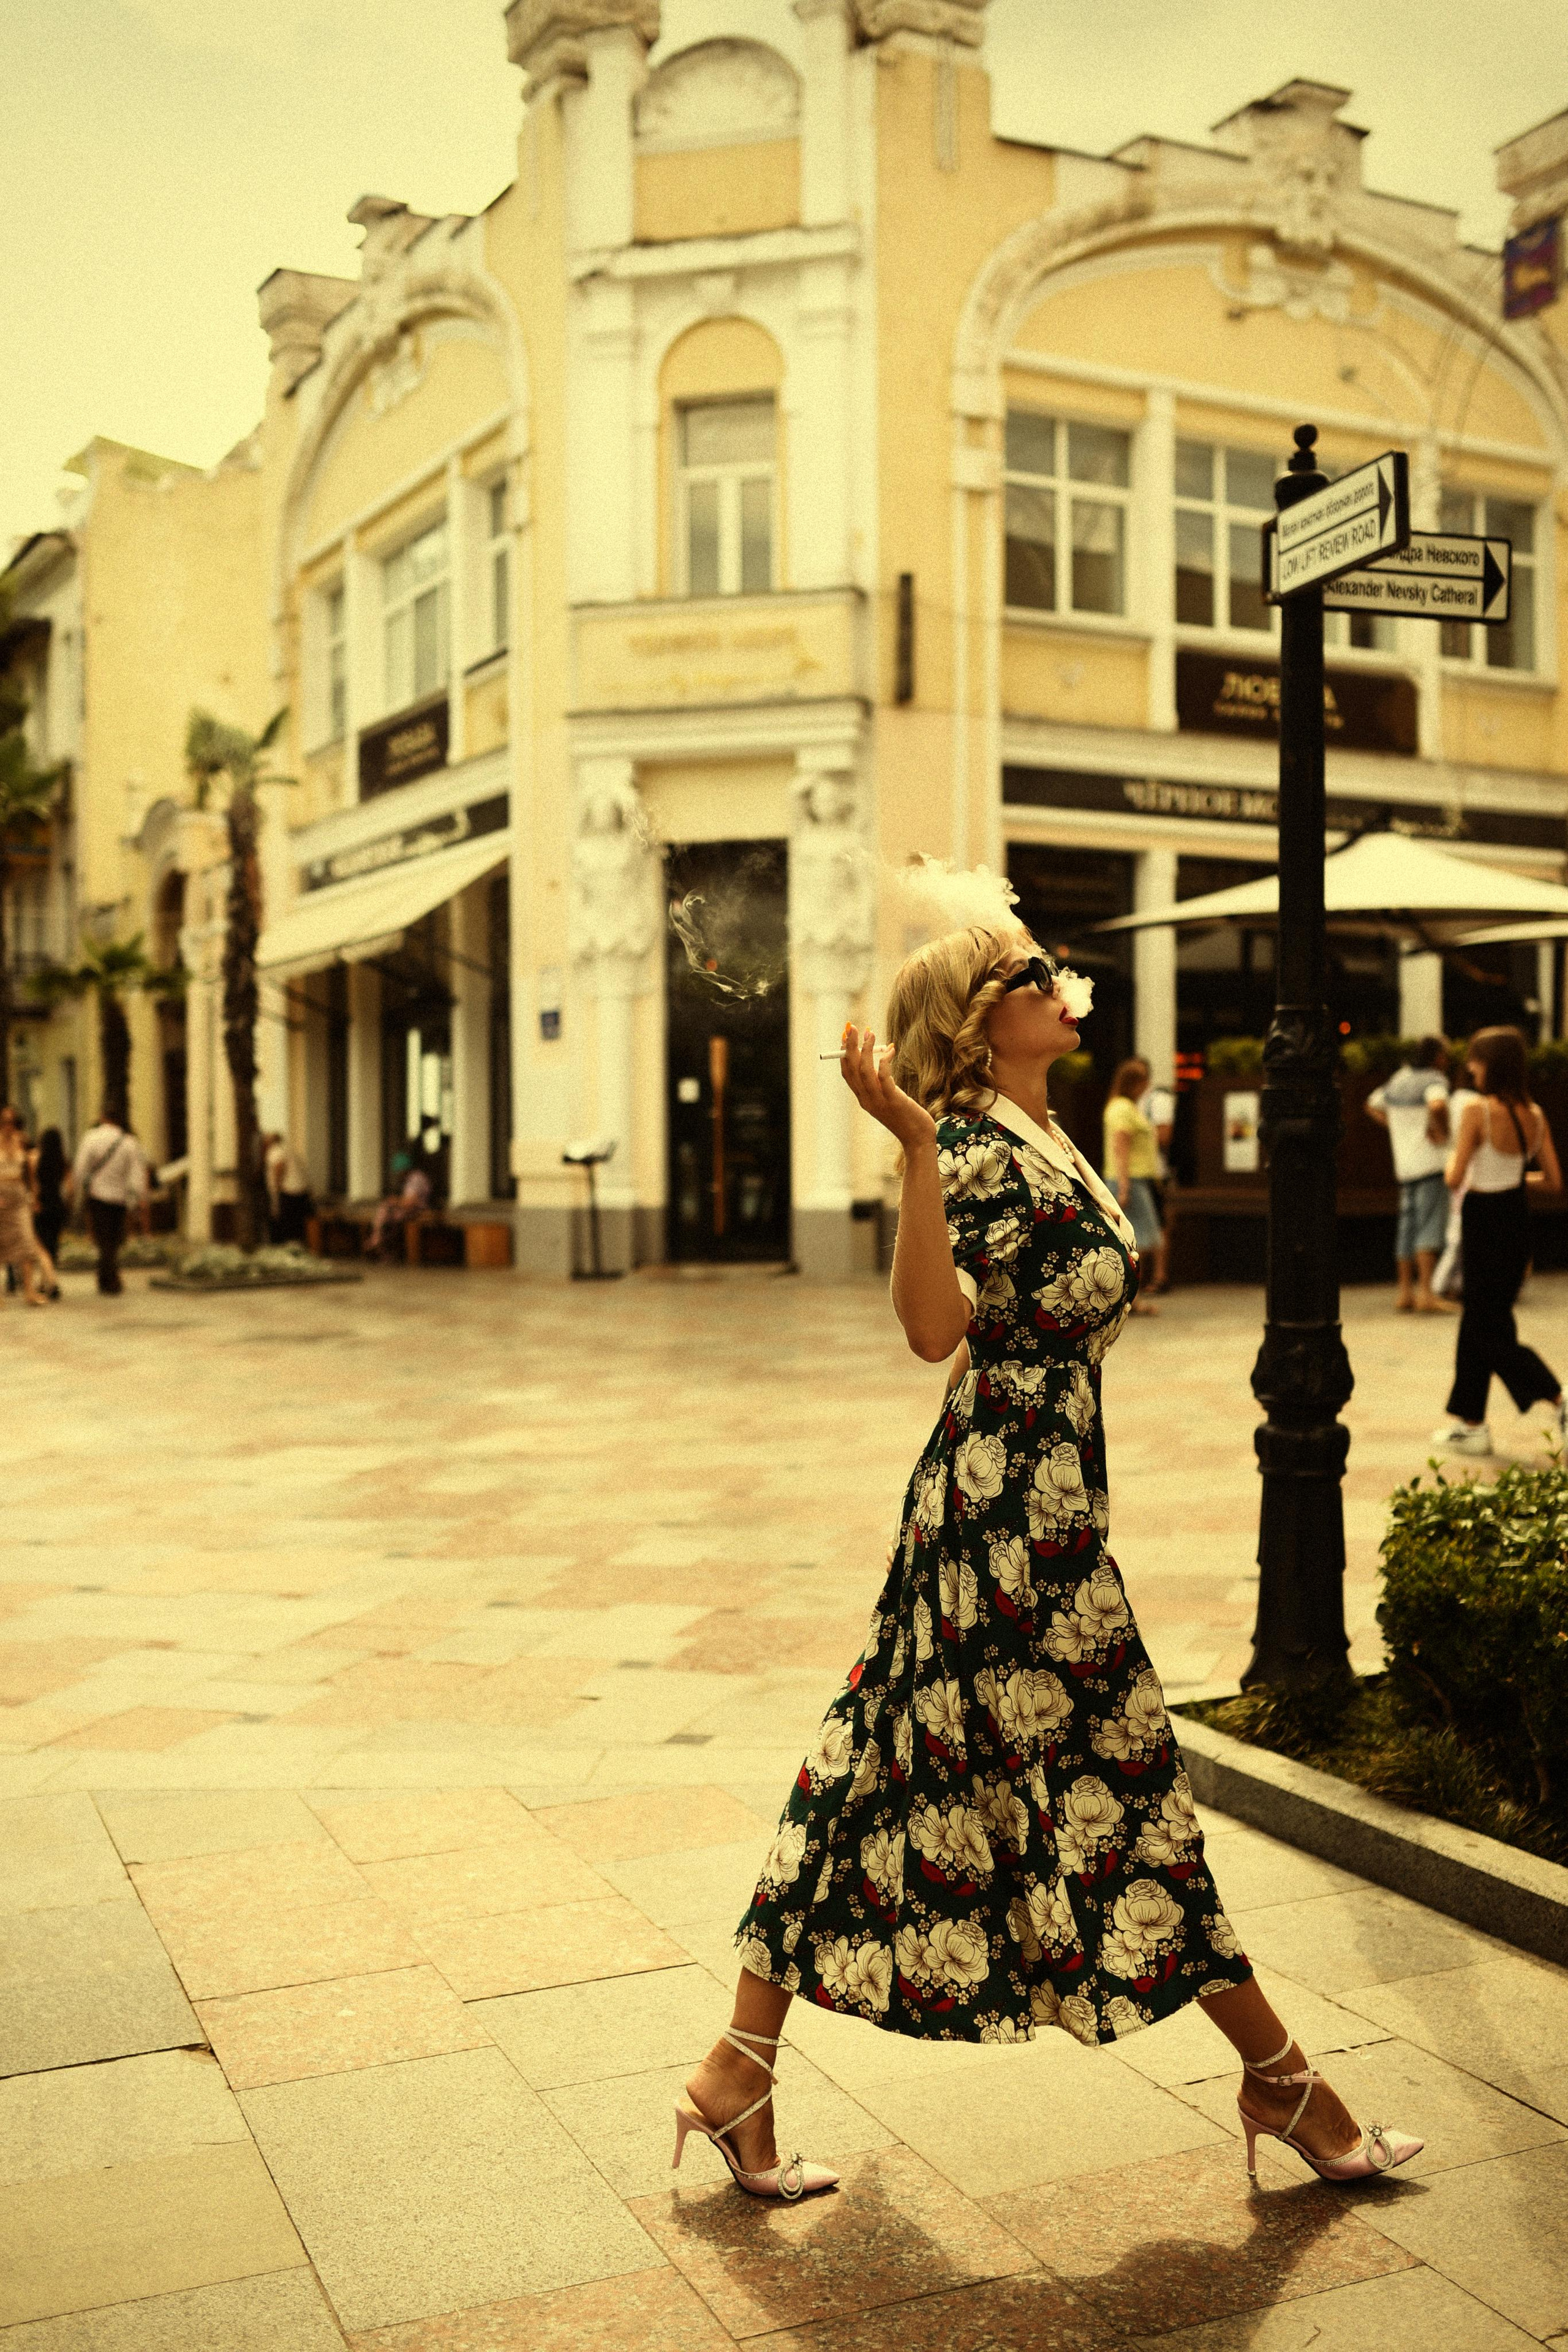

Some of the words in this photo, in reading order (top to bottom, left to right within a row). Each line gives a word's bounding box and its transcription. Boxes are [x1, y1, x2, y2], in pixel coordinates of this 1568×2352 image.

[1283, 554, 1299, 579] LOW
[1319, 535, 1350, 560] REVIEW
[1352, 518, 1376, 545] ROAD
[1426, 545, 1480, 567] Невского
[1326, 578, 1383, 597] Alexander
[1387, 581, 1428, 606] Nevsky
[1431, 584, 1478, 605] Catheral
